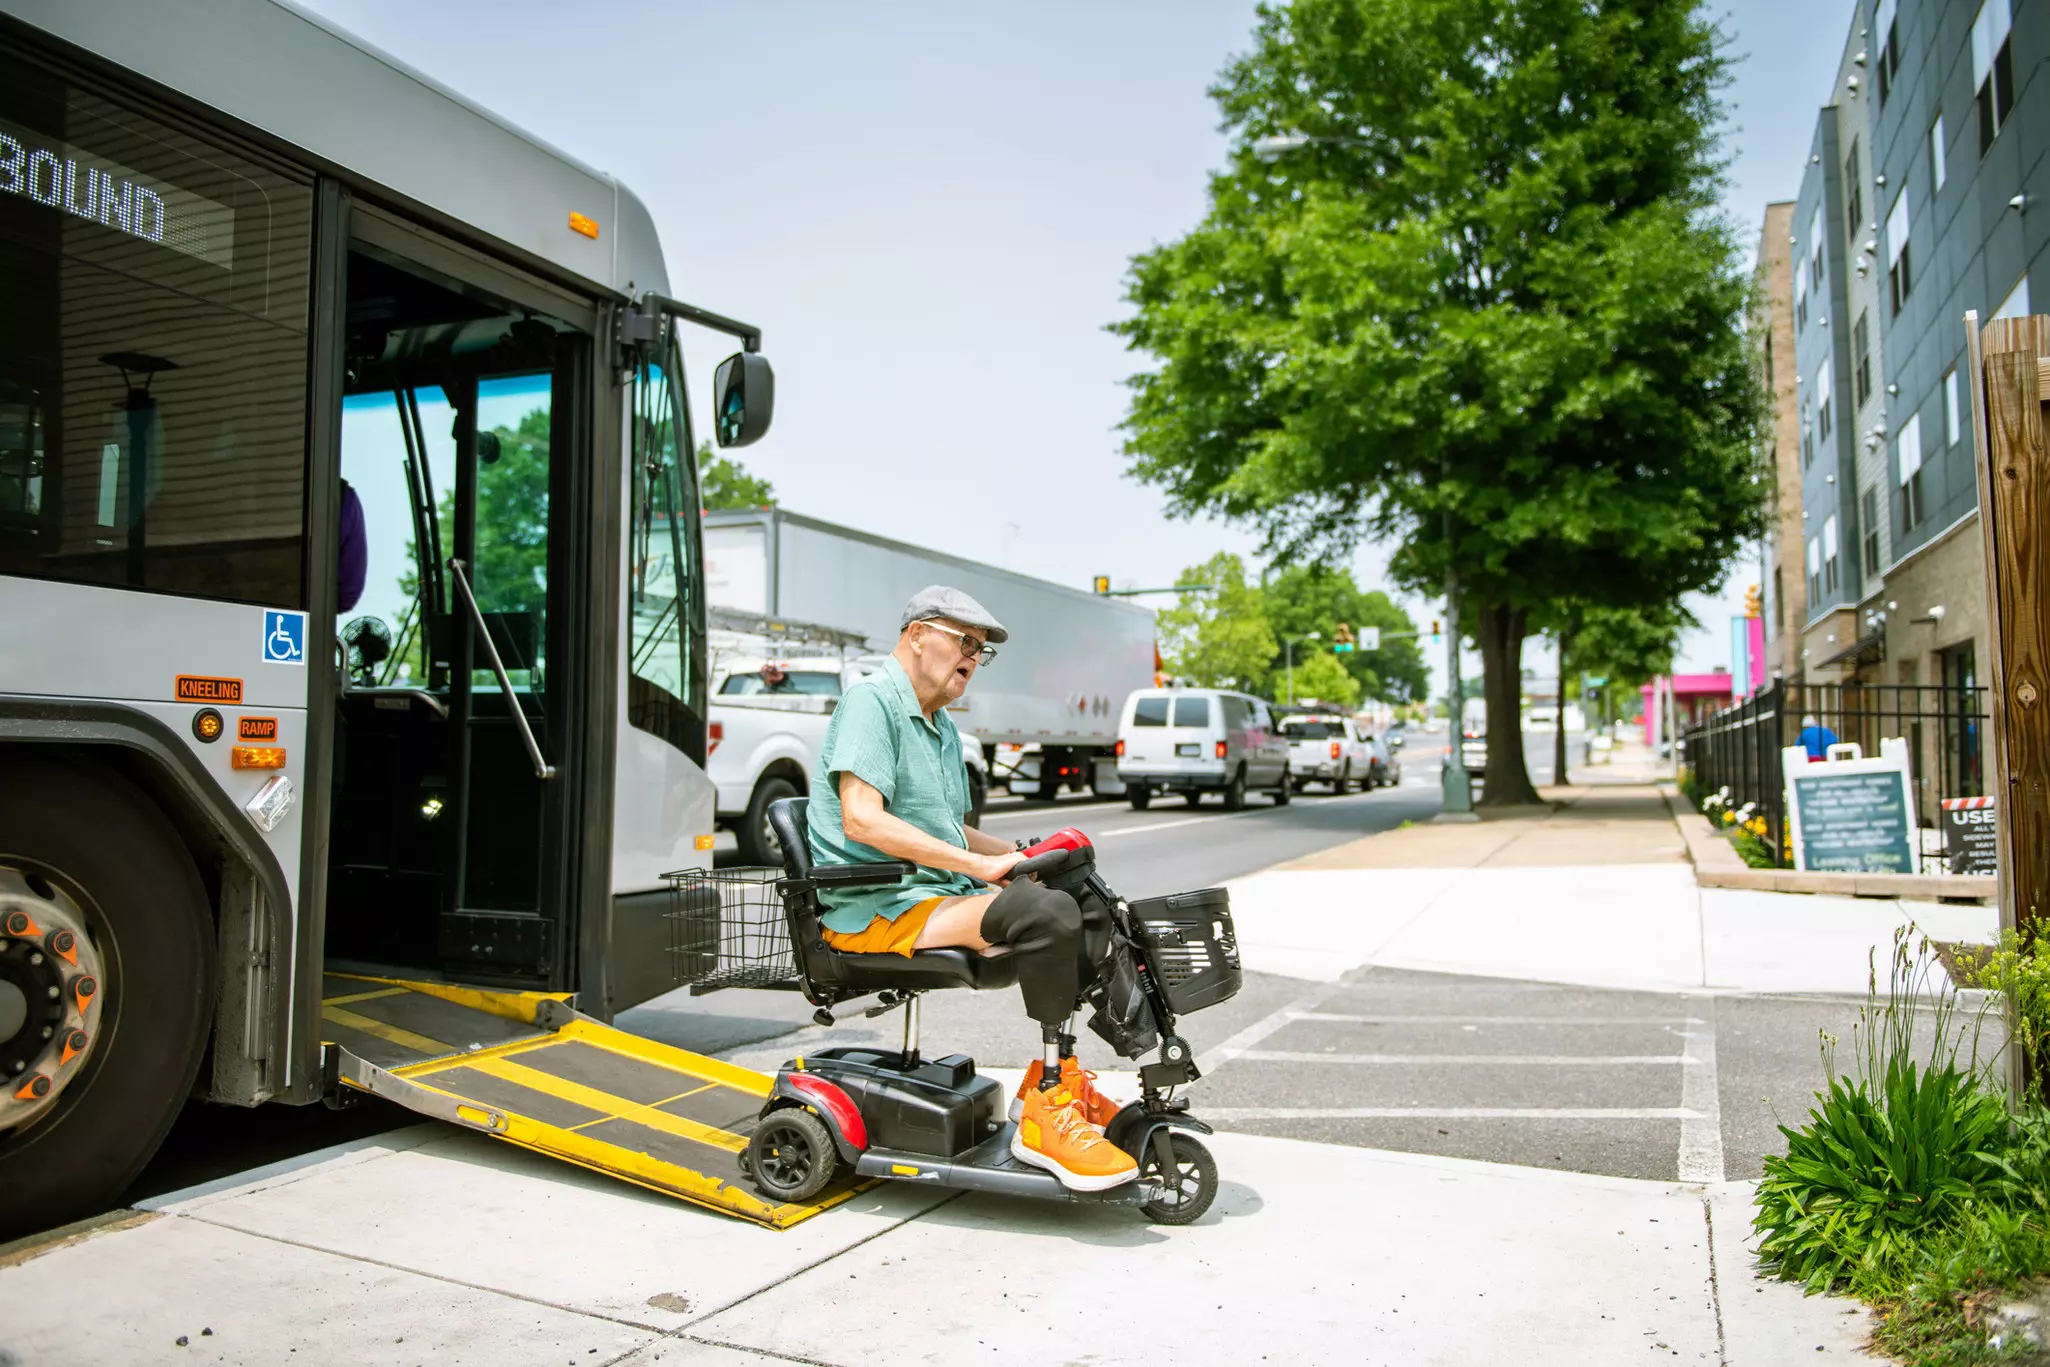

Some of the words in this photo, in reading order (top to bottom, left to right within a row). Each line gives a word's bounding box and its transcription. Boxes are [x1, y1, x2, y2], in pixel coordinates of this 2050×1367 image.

[0, 132, 164, 242] BOUND
[180, 681, 239, 699] KNEELING
[242, 722, 274, 735] RAMP
[1952, 810, 1996, 825] USE
[1864, 852, 1902, 866] Office
